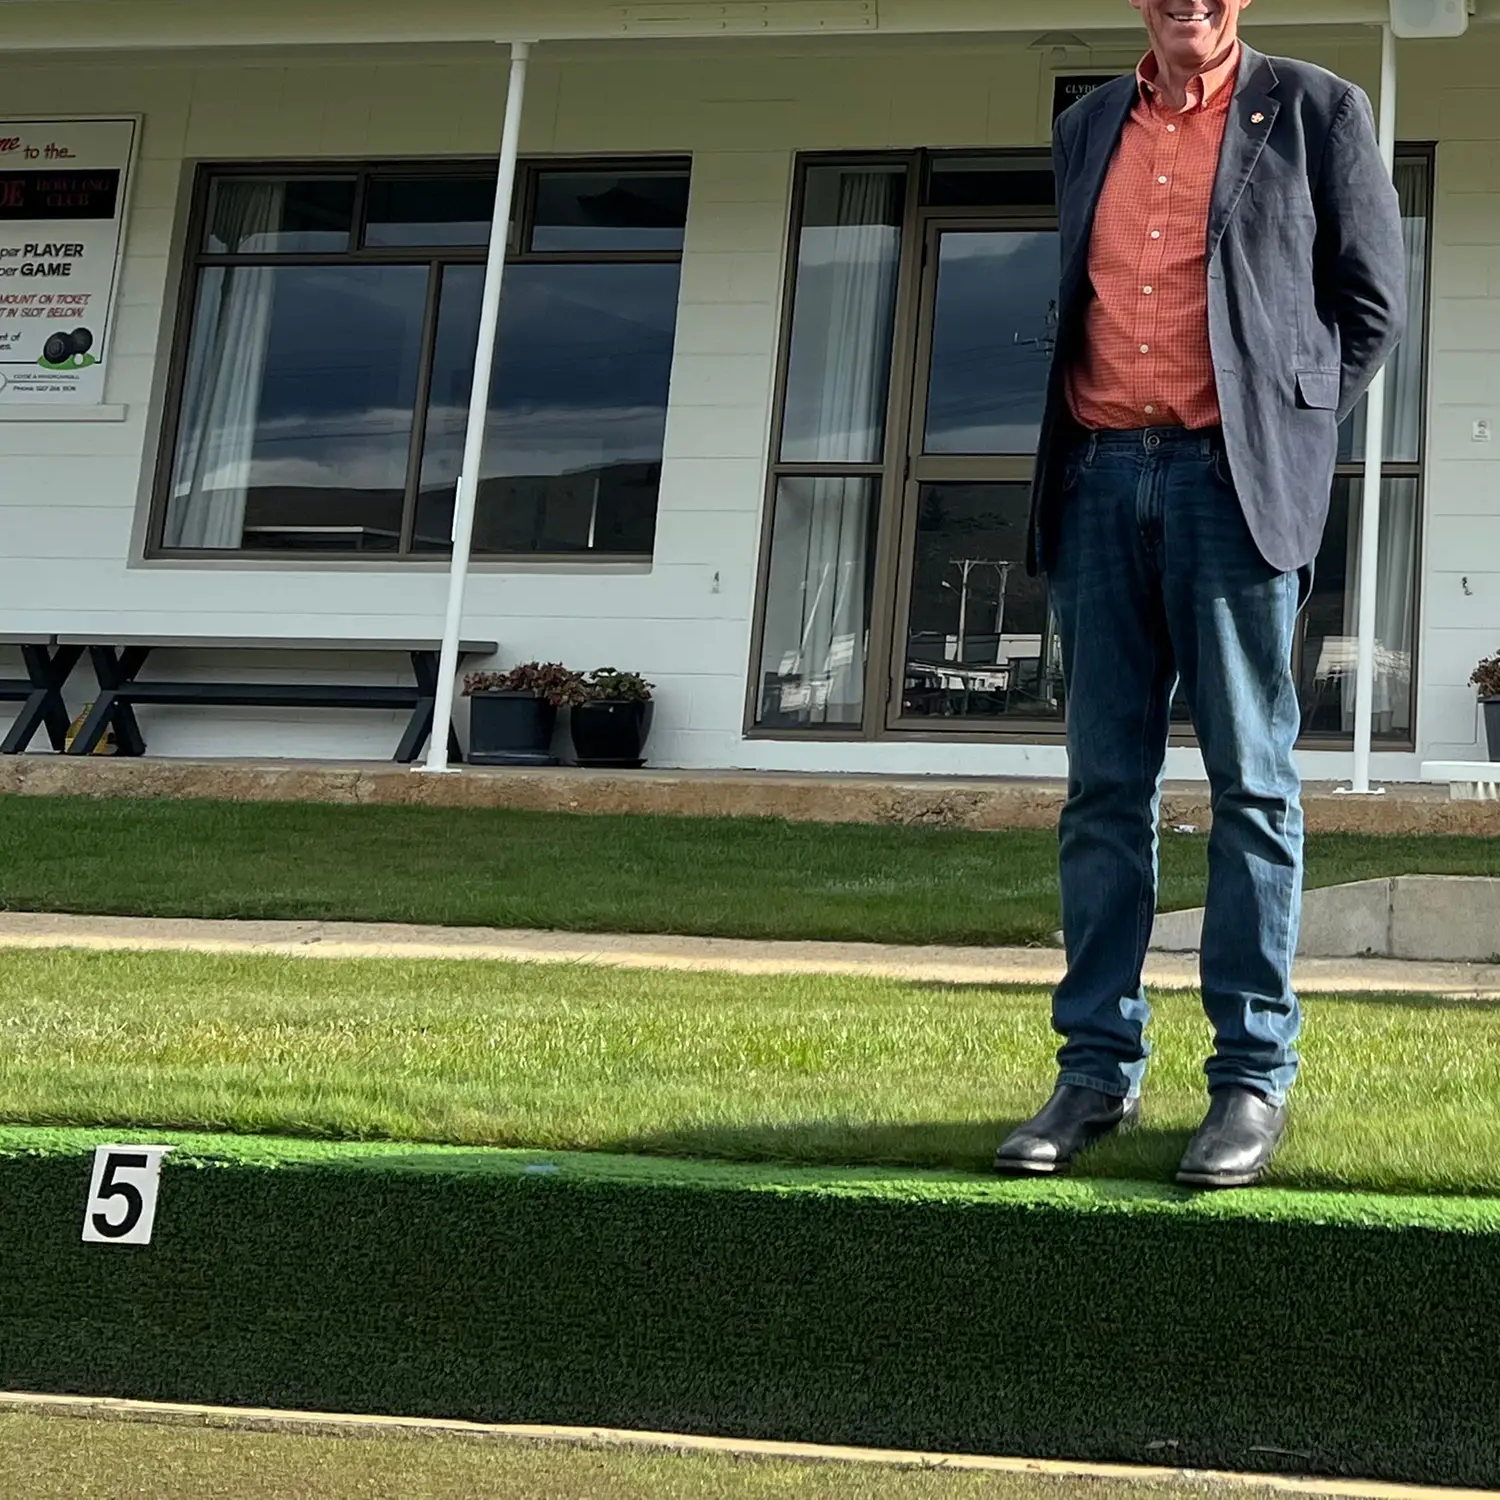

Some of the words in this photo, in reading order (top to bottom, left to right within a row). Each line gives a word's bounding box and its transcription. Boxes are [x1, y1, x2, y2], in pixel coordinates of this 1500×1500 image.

[24, 145, 39, 160] to
[23, 243, 84, 257] PLAYER
[21, 263, 72, 277] GAME
[39, 294, 54, 304] ON
[21, 308, 45, 317] SLOT
[11, 331, 22, 341] of
[92, 1153, 148, 1238] 5
